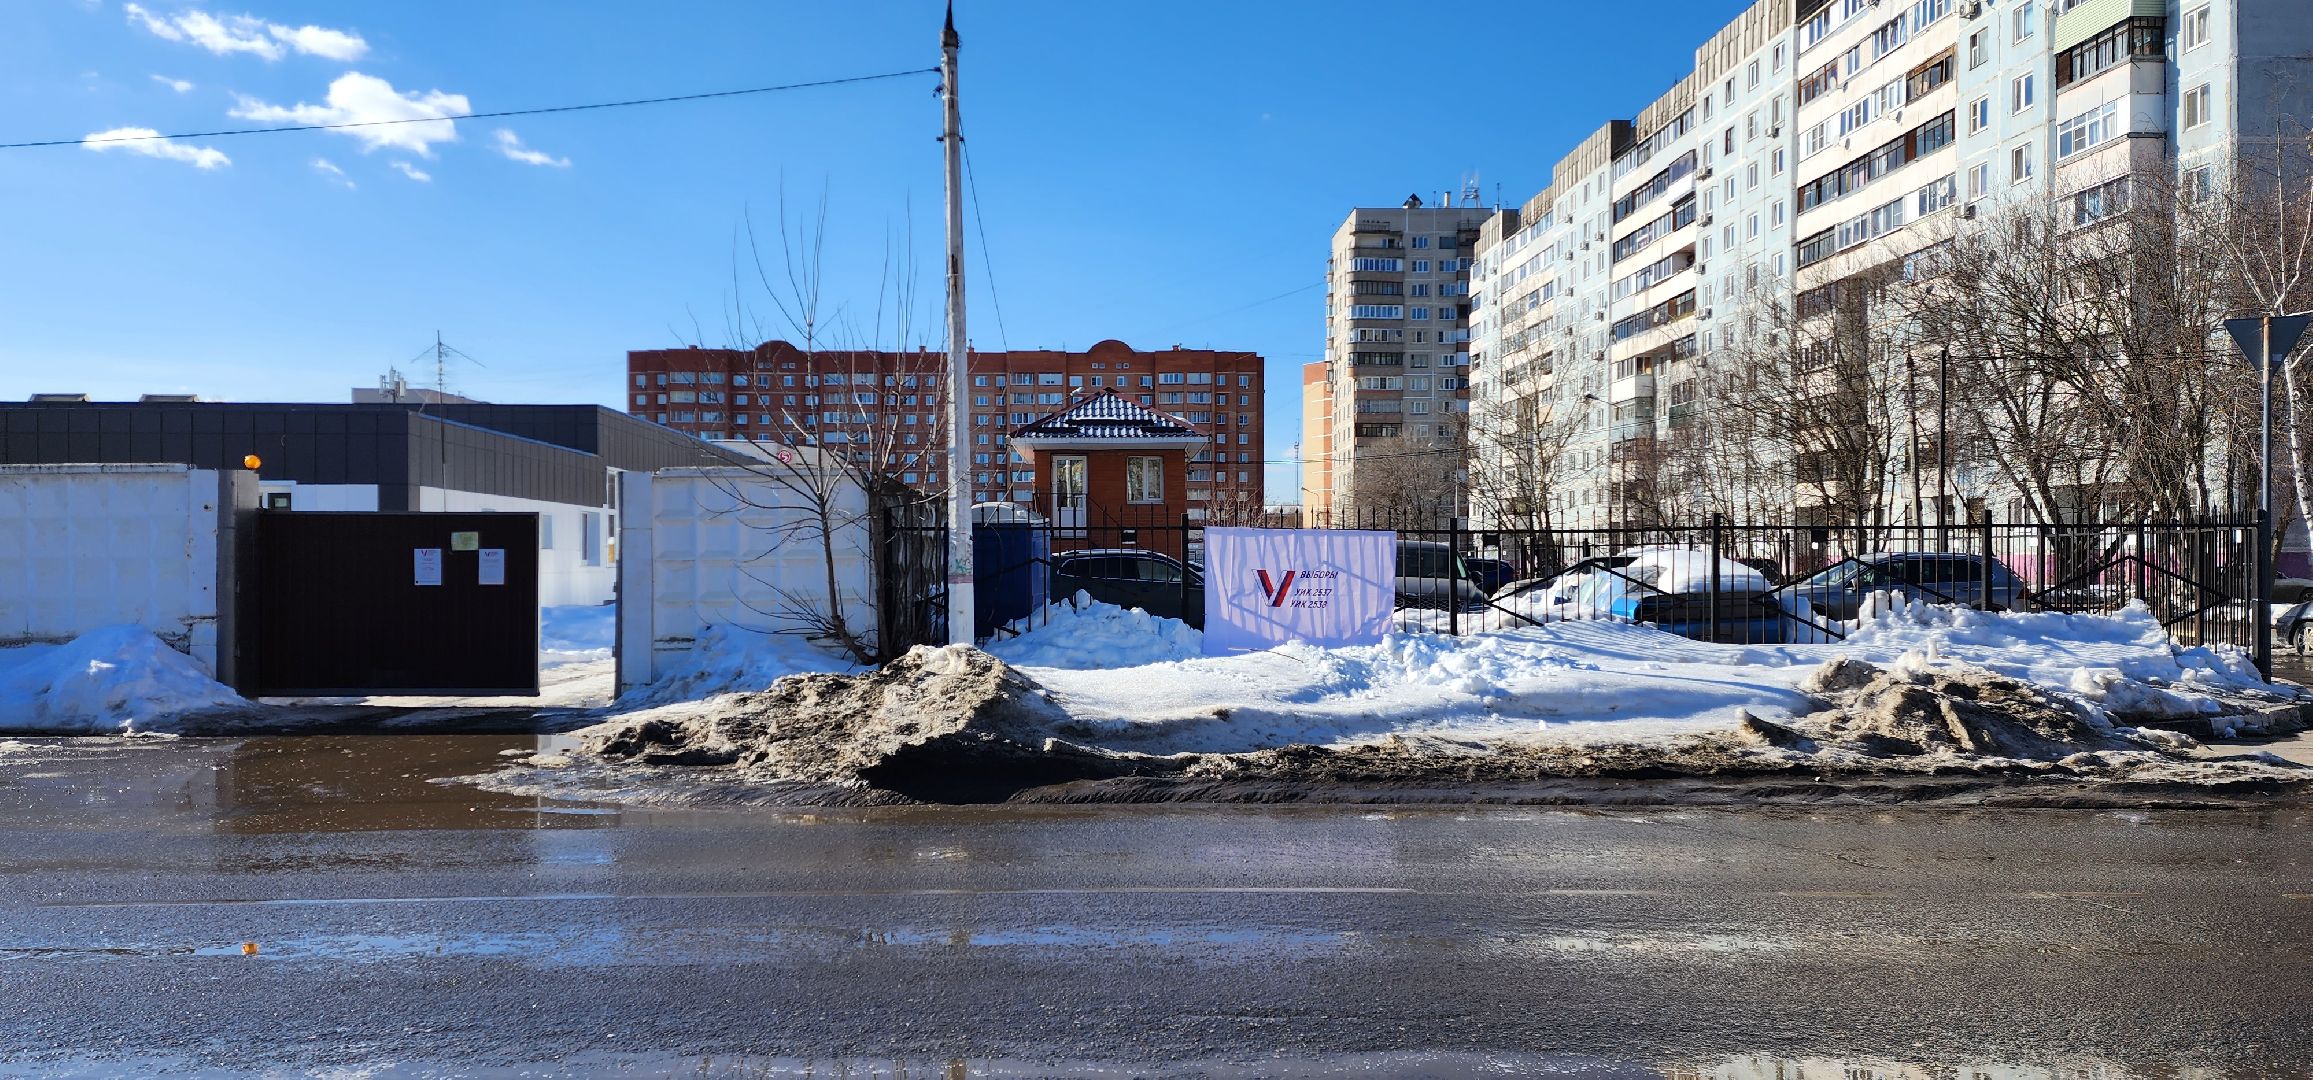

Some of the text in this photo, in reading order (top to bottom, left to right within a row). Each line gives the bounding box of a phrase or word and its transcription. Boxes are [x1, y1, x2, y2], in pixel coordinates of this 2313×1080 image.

[1300, 571, 1338, 579] ВЫБОРЫ
[1290, 600, 1328, 608] УИК 2538
